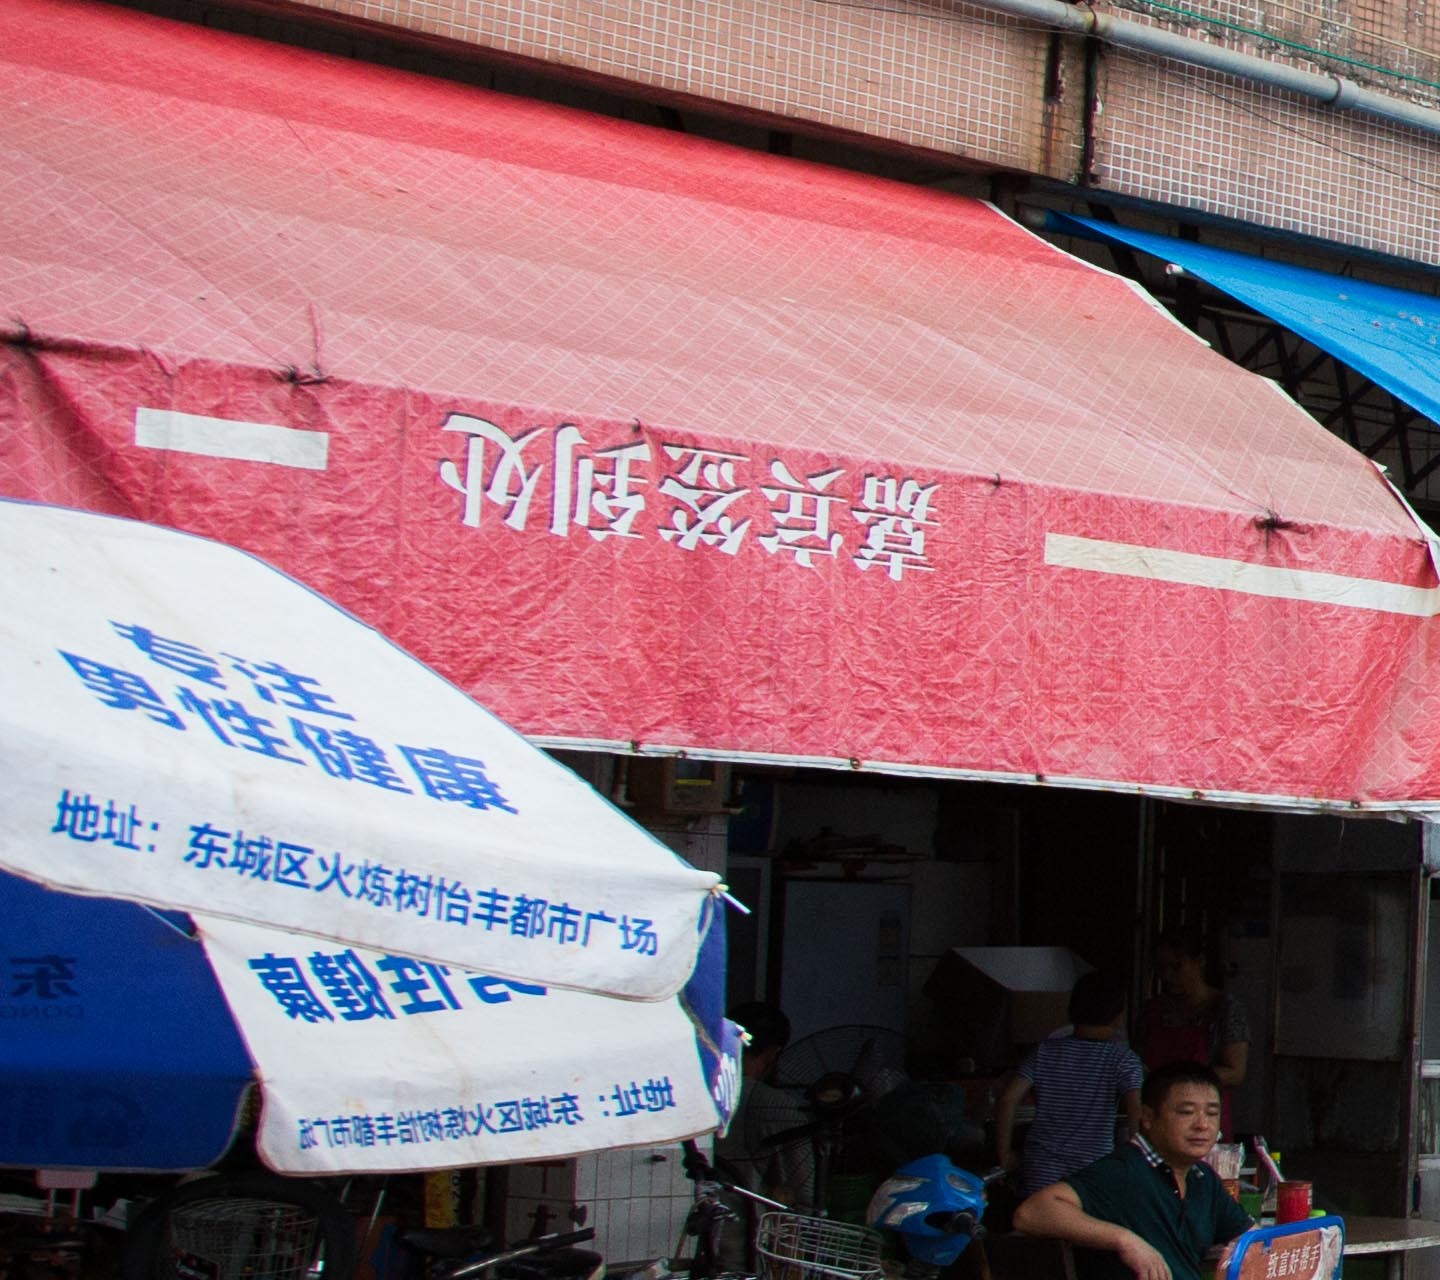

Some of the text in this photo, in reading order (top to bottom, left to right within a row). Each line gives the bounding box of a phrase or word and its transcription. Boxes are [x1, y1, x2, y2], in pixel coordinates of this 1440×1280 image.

[439, 412, 942, 582] 嘉宾签到处
[56, 647, 520, 815] 男性健康
[107, 619, 357, 721] 专注
[1265, 1243, 1320, 1279] 致富好帮手
